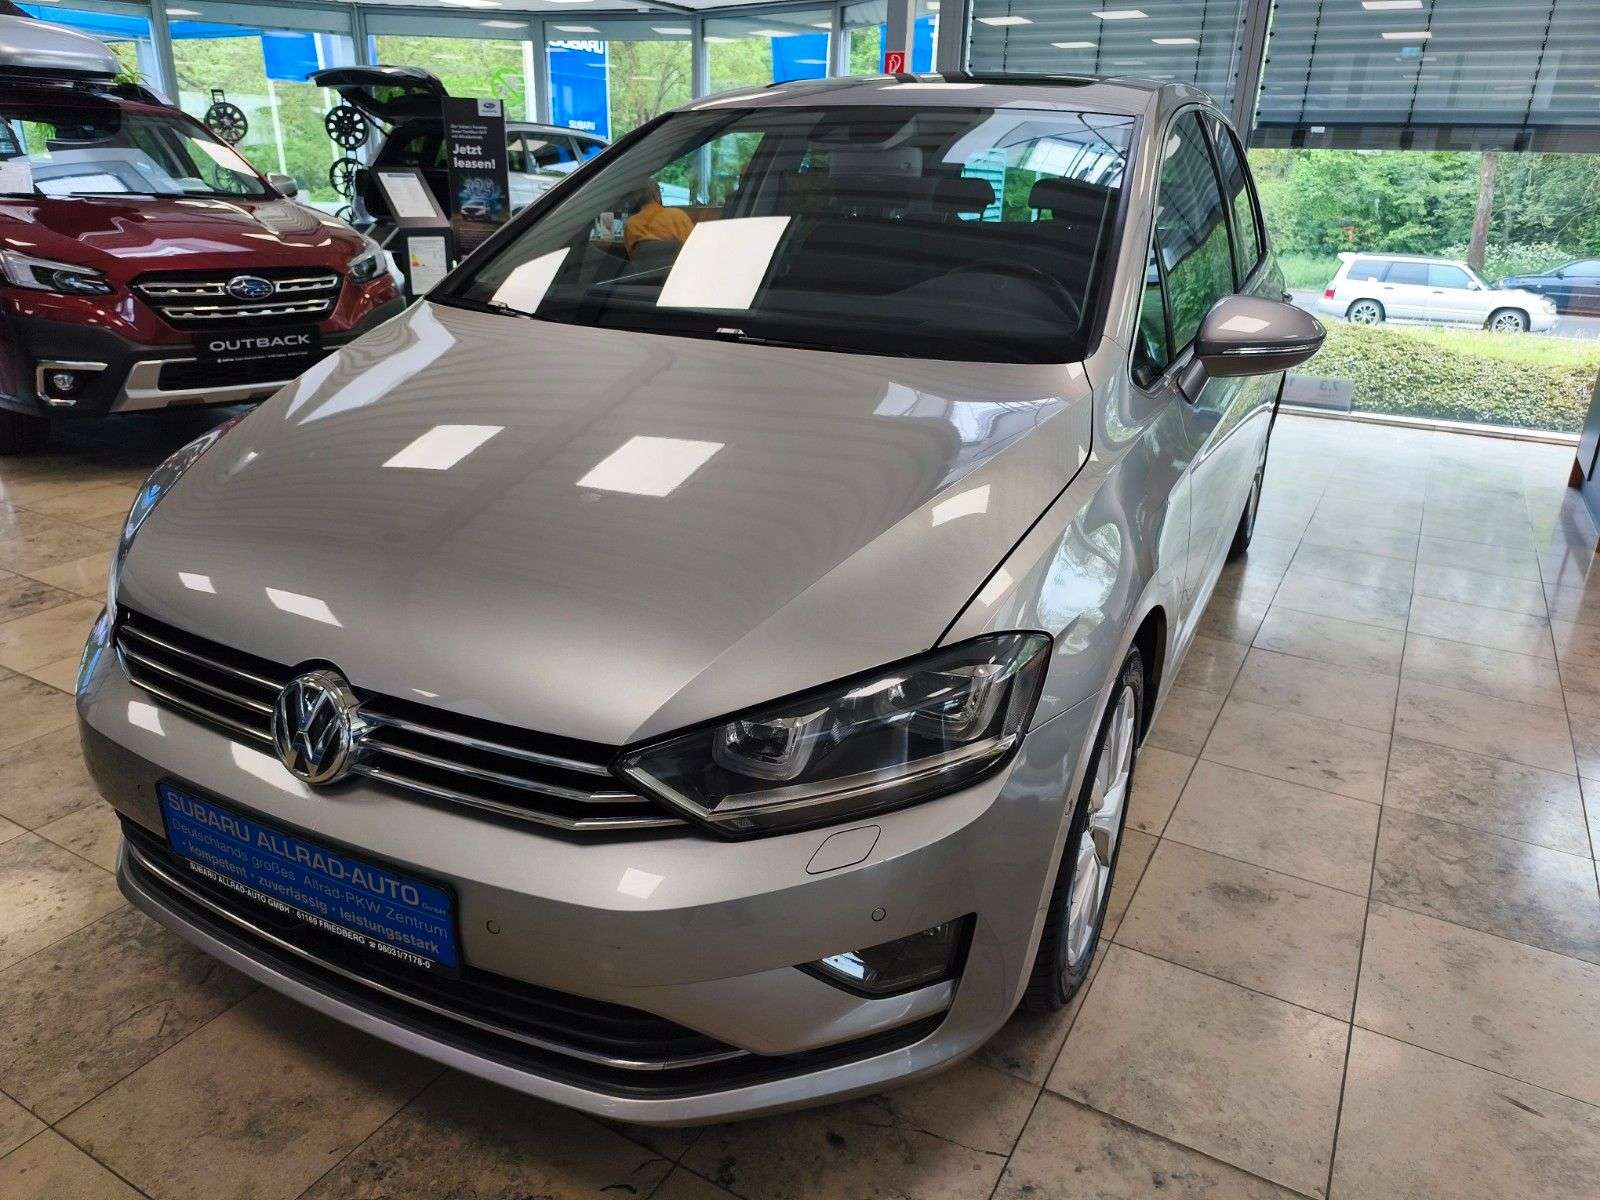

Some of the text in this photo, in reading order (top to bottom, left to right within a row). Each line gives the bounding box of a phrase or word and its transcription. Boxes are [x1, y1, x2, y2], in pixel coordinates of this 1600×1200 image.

[452, 143, 482, 156] Jetzt
[453, 156, 496, 169] leasen!
[209, 334, 310, 352] OUTBACK
[167, 791, 250, 842] SUBARU
[257, 831, 419, 906] ALLRAD-AUTO
[172, 818, 448, 940] Deutschlands großes Allrad-PKW Zentrum
[187, 841, 248, 879] kompetent
[340, 907, 440, 954] leistungsstark
[190, 862, 217, 881] SUBARU
[218, 876, 267, 903] ALLRAD-AUTO
[267, 899, 290, 914] GMBH
[319, 920, 365, 945] FRIEDBERG
